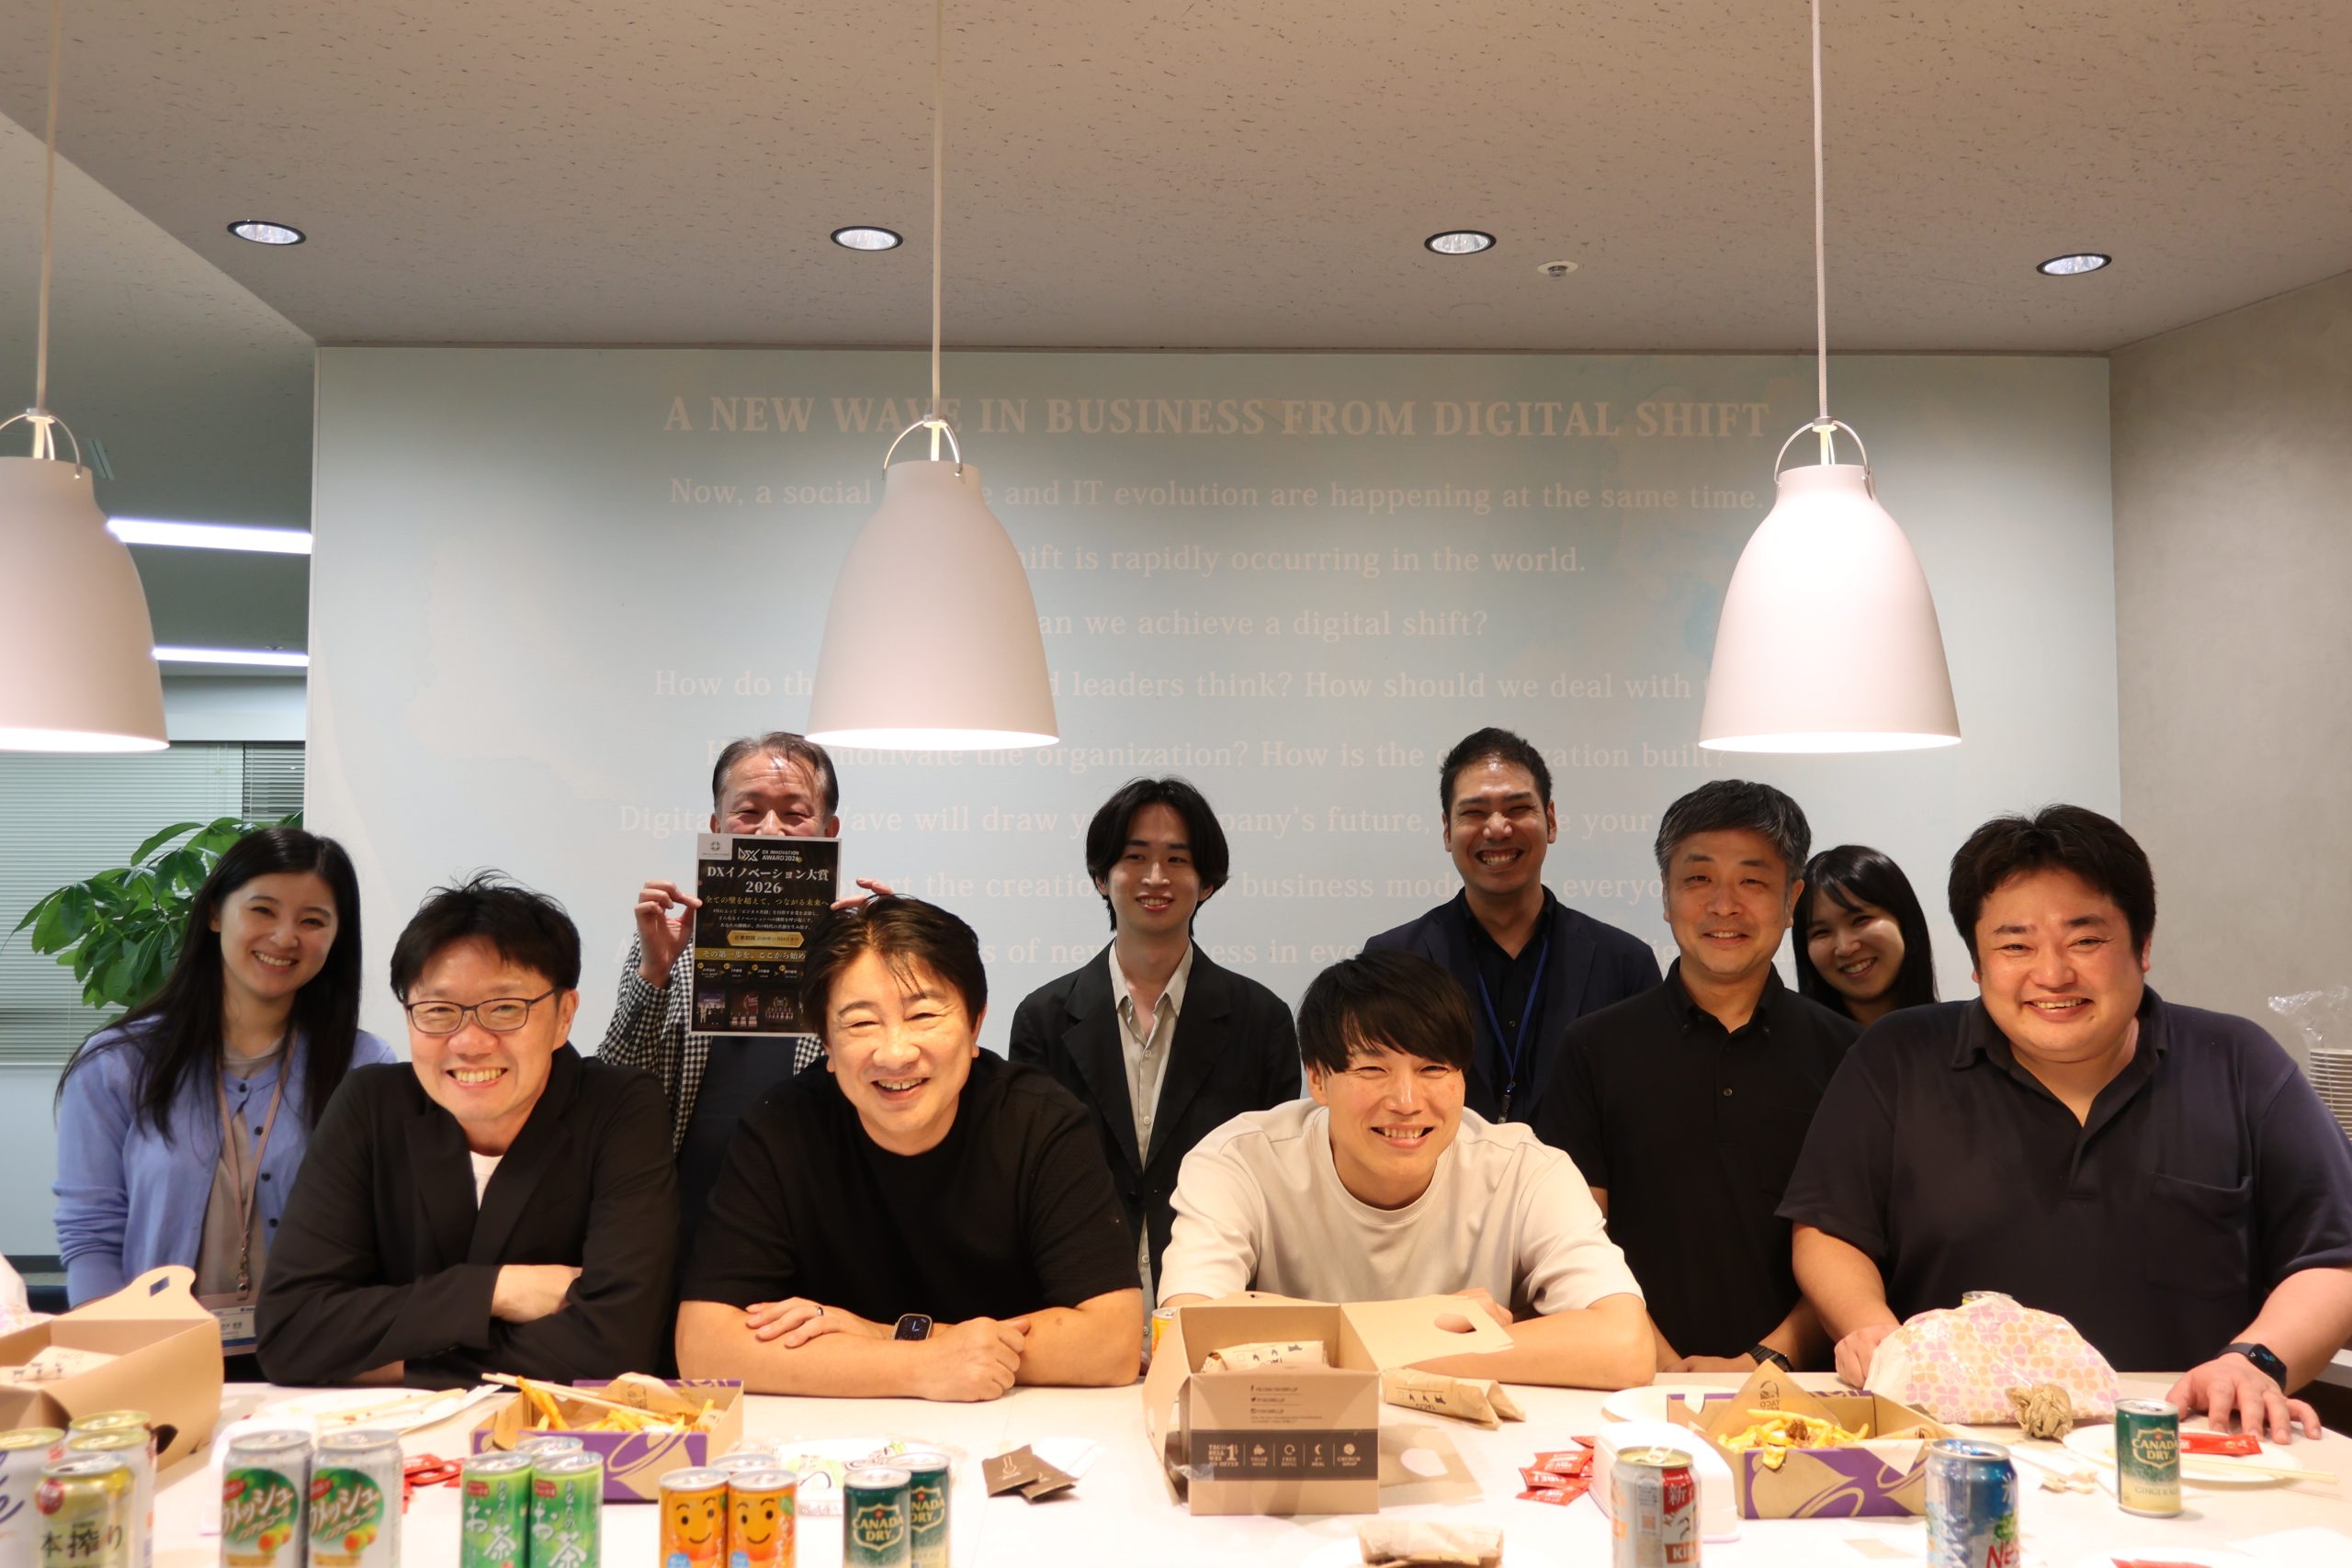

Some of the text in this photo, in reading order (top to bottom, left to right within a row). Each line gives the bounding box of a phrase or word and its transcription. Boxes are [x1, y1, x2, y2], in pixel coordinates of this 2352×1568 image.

[663, 397, 1770, 437] A NEW WAVE IN BUSINESS FROM DIGITAL SHIFT
[670, 478, 743, 507] Now,
[755, 487, 773, 505] a
[783, 479, 872, 505] social
[1005, 479, 1059, 505] and
[1071, 480, 1103, 505] IT
[1114, 480, 1259, 508] evolution
[1270, 490, 1318, 508] are
[1330, 481, 1491, 514] happening
[1502, 484, 1532, 508] at
[1542, 482, 1590, 508] the
[1601, 491, 1678, 509] same
[1690, 484, 1763, 510] time.
[1074, 546, 1099, 570] is
[1111, 546, 1220, 578] rapidly
[1231, 547, 1380, 578] occurring
[1392, 547, 1420, 571] in
[1433, 547, 1480, 572] the
[1492, 547, 1586, 572] world.
[1038, 608, 1488, 642] an we achieve a digital shift?
[654, 671, 722, 695] How
[734, 670, 772, 695] do
[1072, 671, 1184, 697] leaders
[1196, 671, 1291, 698] think?
[1305, 672, 1373, 698] How
[1384, 672, 1486, 699] should
[1498, 680, 1540, 699] we
[1550, 672, 1613, 698] deal
[1624, 672, 1691, 699] with
[976, 740, 1024, 766] the
[1035, 739, 1249, 774] organization?
[1261, 742, 1329, 767] How
[1340, 742, 1365, 767] is
[1376, 741, 1425, 768] the
[618, 805, 709, 840] Digita
[841, 807, 902, 831] ave
[914, 806, 970, 831] will
[982, 806, 1059, 831] draw
[1217, 807, 1316, 840] pany's
[1327, 806, 1430, 835] future,
[1581, 813, 1653, 840] your
[707, 866, 830, 882] DXイノベーション大賞
[745, 881, 781, 894] 2026
[926, 869, 978, 897] the
[986, 871, 1093, 897] creatio
[1242, 871, 1374, 897] business
[1008, 937, 1041, 964] of
[1268, 939, 1300, 964] in
[2146, 1450, 2170, 1461] DRY
[910, 1496, 945, 1512] NADA
[852, 1515, 905, 1530] CANADA
[865, 1529, 893, 1542] DRY
